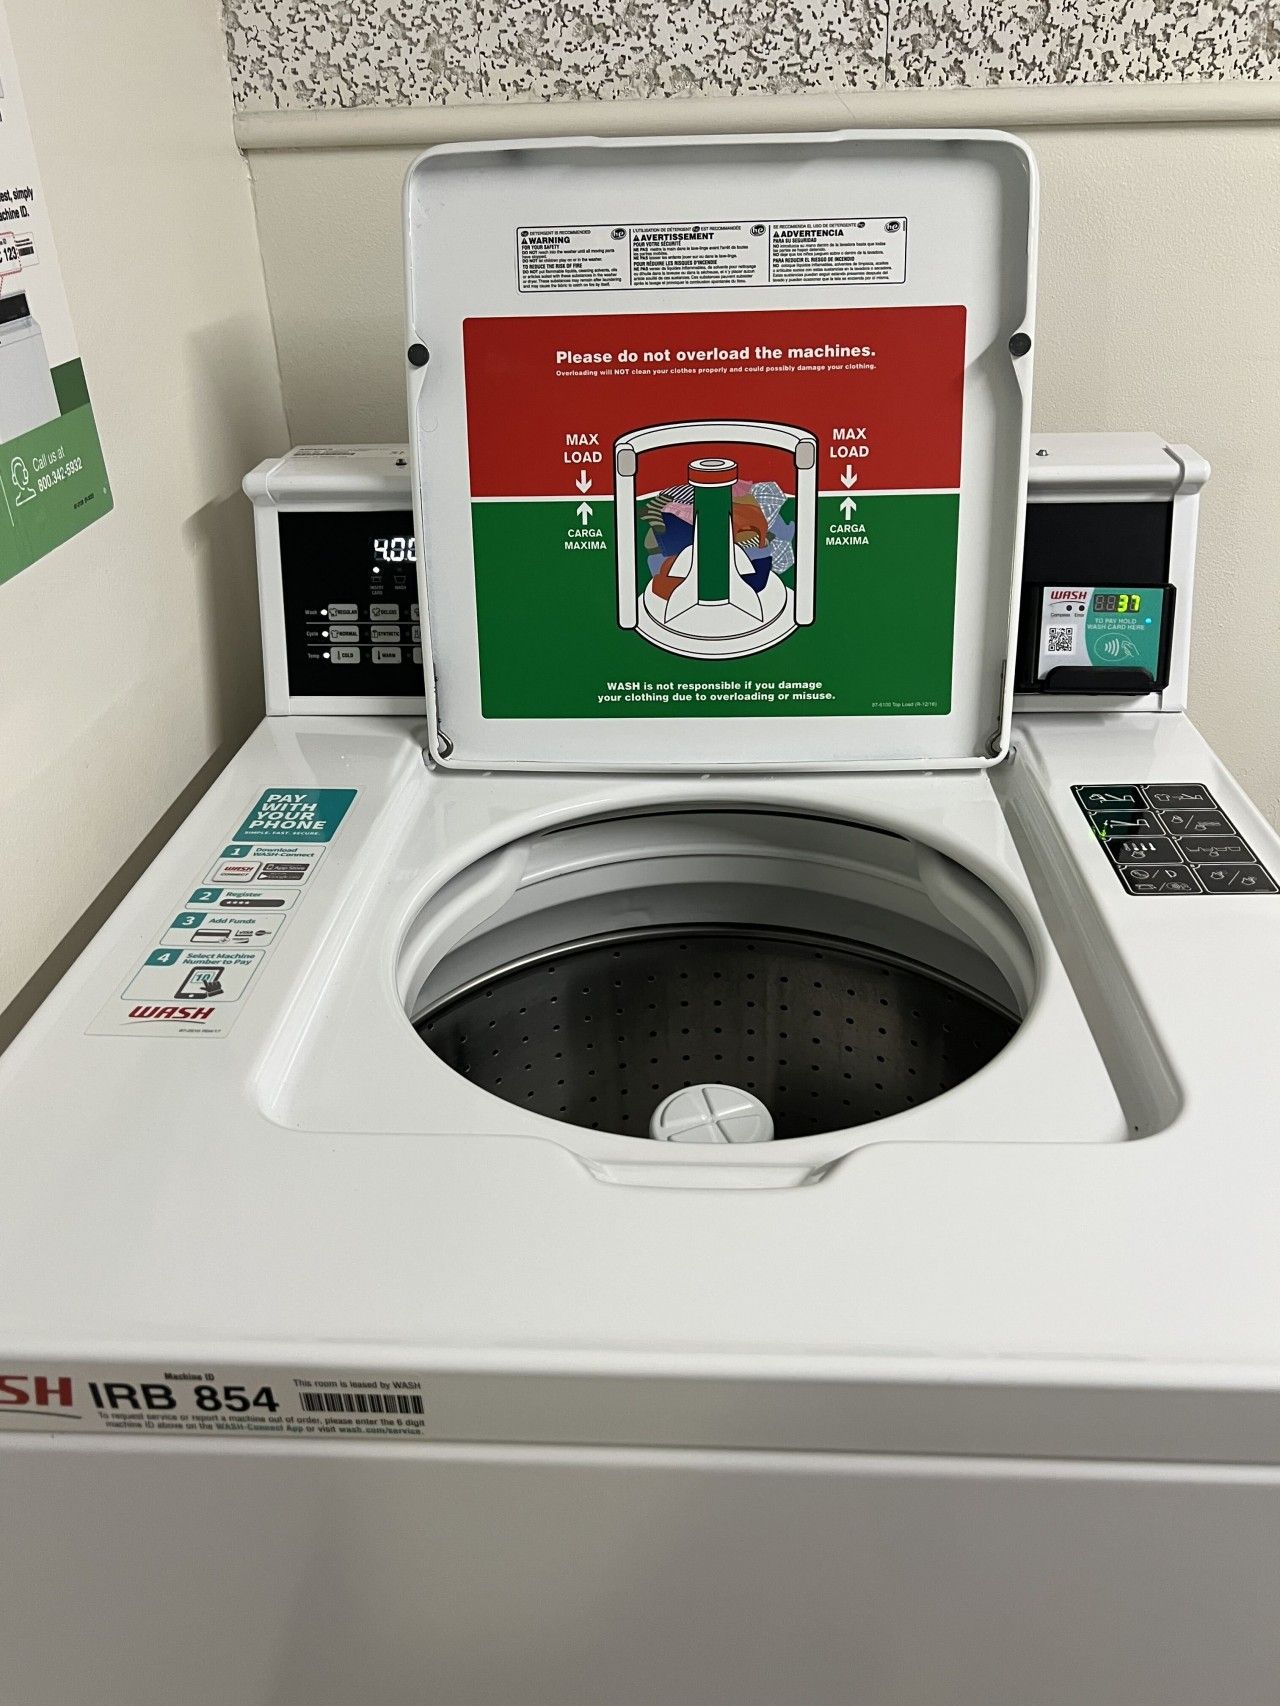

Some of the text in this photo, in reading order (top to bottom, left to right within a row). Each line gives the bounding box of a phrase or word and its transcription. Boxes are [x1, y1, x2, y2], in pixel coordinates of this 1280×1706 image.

[13, 185, 33, 201] simply
[641, 233, 714, 241] AVERTISSEMENT
[781, 229, 844, 238] ADVERTENCIA
[529, 236, 570, 245] WARNING
[556, 344, 876, 364] Please do not overload the machines.
[765, 365, 795, 373] possibly
[832, 428, 867, 440] MAX
[565, 433, 599, 446] MAX
[830, 446, 869, 458] LOAD
[33, 446, 65, 471] Call us at
[564, 451, 603, 464] LOAD
[829, 524, 866, 533] CARGA
[567, 529, 603, 538] CARGA
[825, 536, 870, 545] MAXIMA
[564, 541, 607, 550] MAXIMA
[1051, 591, 1088, 600] WASH
[607, 681, 822, 691] WASH is not responsible if you damage
[597, 695, 622, 703] your
[625, 693, 669, 703] clothing
[672, 693, 692, 701] due
[695, 693, 707, 701] to
[710, 692, 774, 702] overloading
[792, 692, 836, 700] misuse.
[267, 794, 307, 802] PAY
[262, 803, 318, 811] WITH
[257, 812, 315, 820] YOUR
[248, 820, 327, 829] PHONE
[230, 848, 241, 856] 1
[199, 892, 212, 900] 2
[182, 916, 195, 925] 3
[157, 953, 171, 962] 4
[128, 1006, 215, 1019] WASH
[205, 1373, 215, 1381] ID
[293, 1379, 312, 1387] This
[379, 1382, 390, 1390] by
[88, 1382, 280, 1412] IRB 854
[111, 1413, 143, 1421] request
[405, 1419, 425, 1427] digit
[286, 1424, 303, 1432] App
